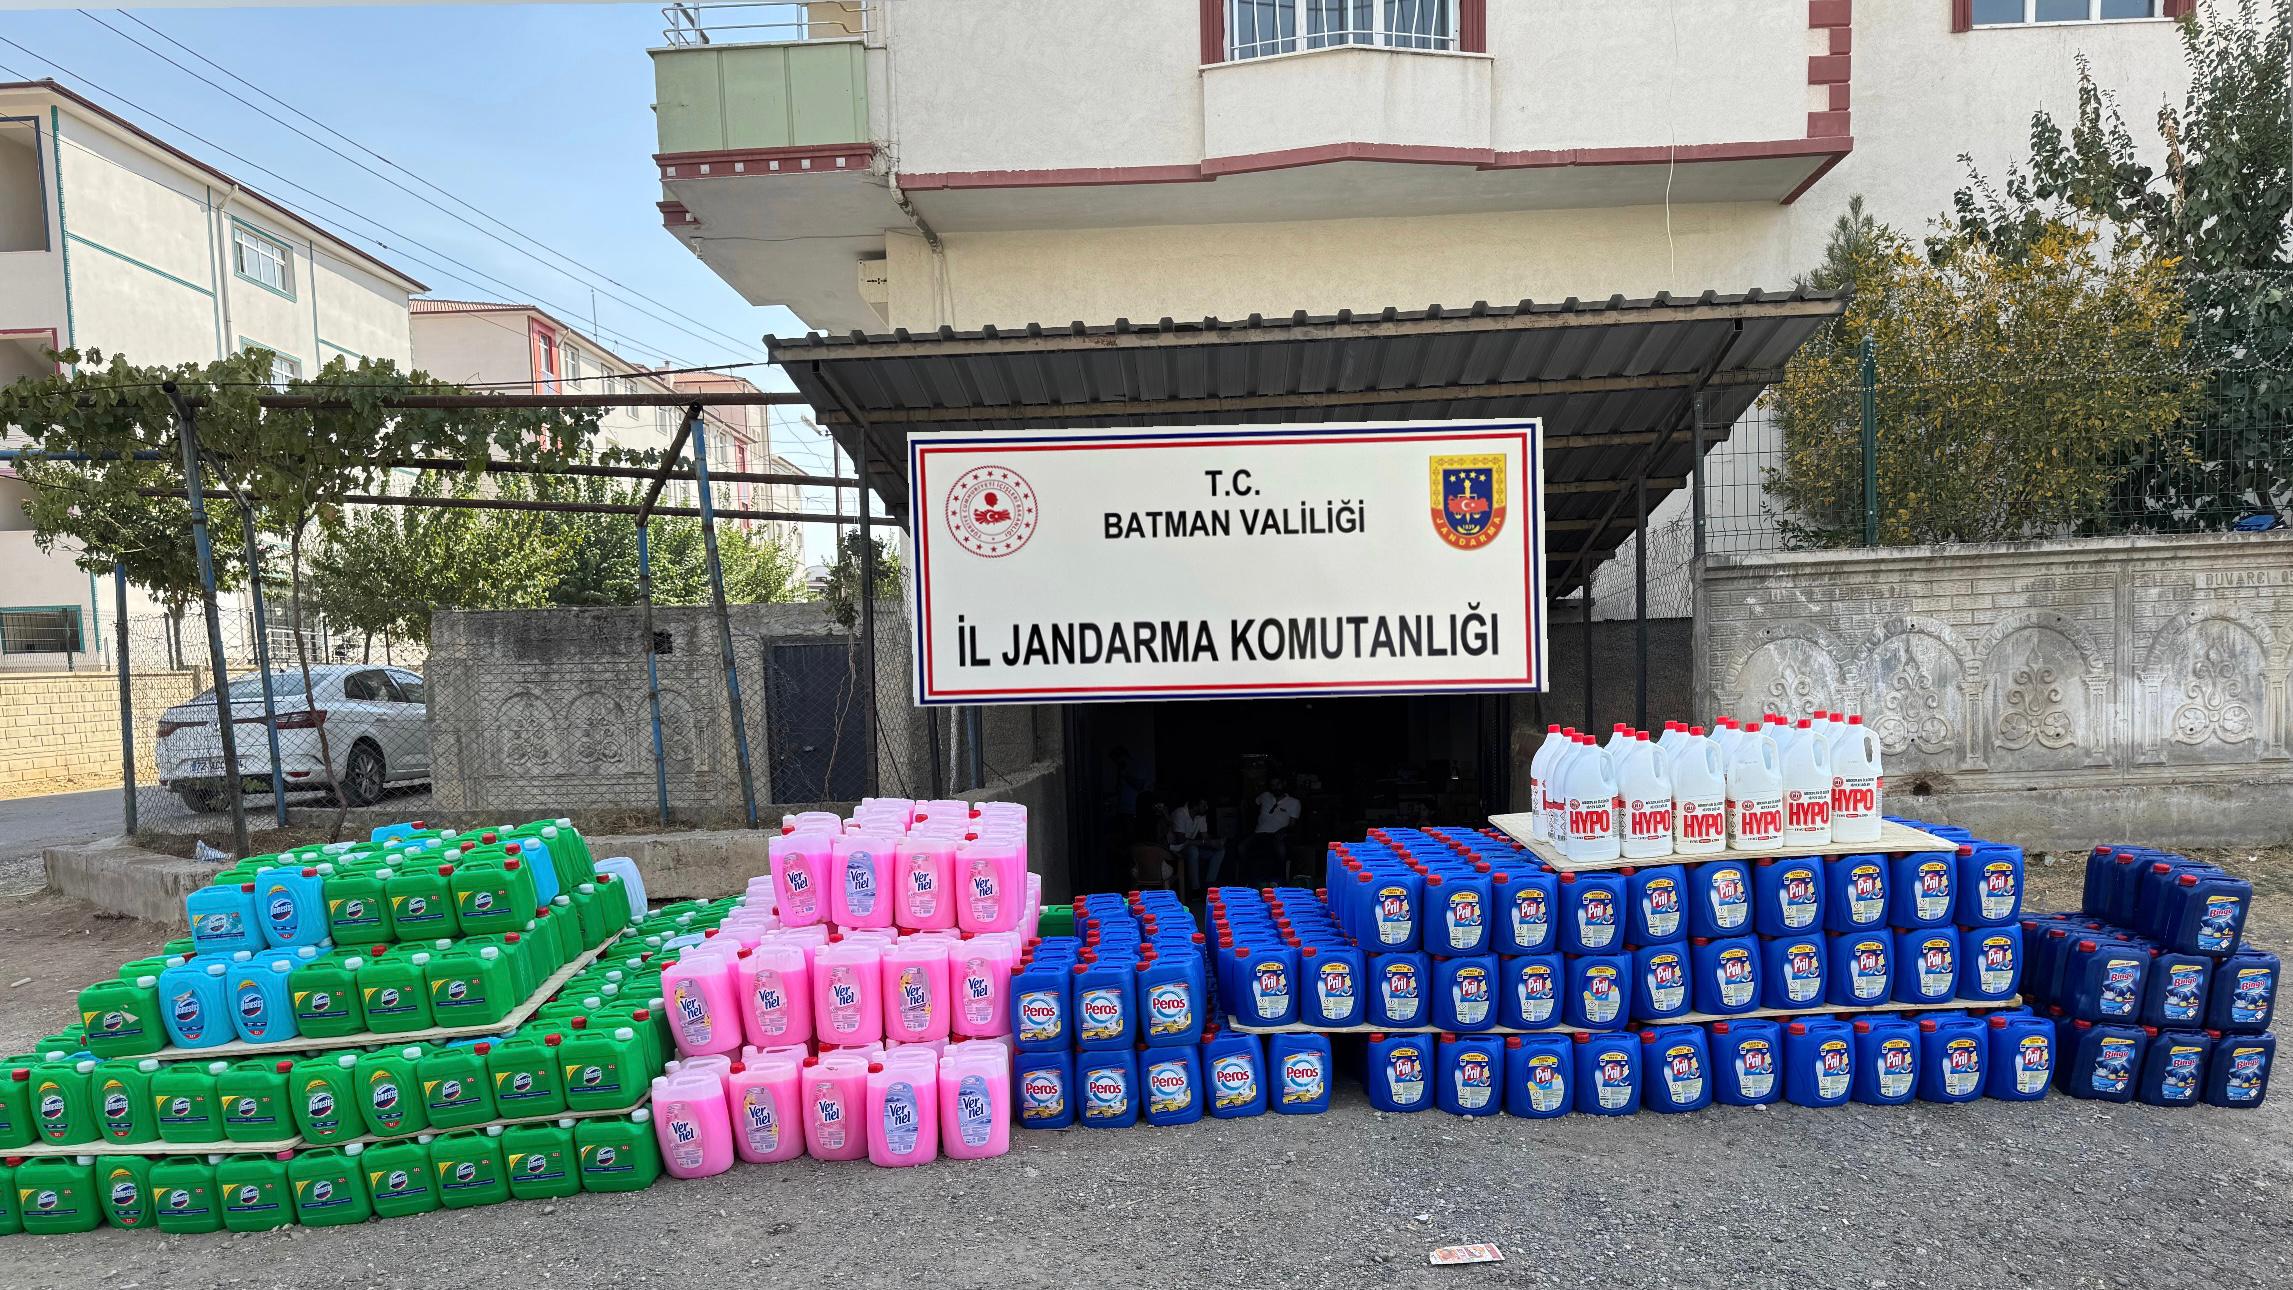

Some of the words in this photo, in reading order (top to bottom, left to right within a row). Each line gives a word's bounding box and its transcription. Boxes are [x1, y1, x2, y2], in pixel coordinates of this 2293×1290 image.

[1205, 470, 1260, 496] T.C.
[1105, 510, 1229, 538] BATMAN
[1243, 499, 1365, 535] VALİLİĞİ
[1436, 517, 1501, 546] JANDARMA
[958, 614, 990, 666] İL
[1002, 621, 1218, 666] JANDARMA
[1231, 602, 1498, 662] KOMUTANLIĞI
[1831, 788, 1873, 811] HYPO
[1789, 801, 1829, 826] HYPO
[1570, 810, 1610, 834] HYPO
[1632, 810, 1670, 834] HYPO
[1683, 813, 1723, 837] HYPO
[1742, 810, 1781, 834] HYPO
[1858, 878, 1872, 891] Pril
[1924, 876, 1939, 889] Pril
[1990, 876, 2004, 889] Pril
[1720, 884, 1734, 897] Pril
[1790, 884, 1804, 897] Pril
[1652, 893, 1667, 906] Pril
[1384, 901, 1399, 914] Pril
[1457, 906, 1471, 919] Pril
[1522, 903, 1536, 916] Pril
[1588, 904, 1602, 917] Pril
[1860, 956, 1875, 969] Pril
[1928, 953, 1942, 966] Pril
[1988, 950, 2002, 964] Pril
[1727, 962, 1741, 976] Pril
[1794, 959, 1808, 972] Pril
[1656, 968, 1671, 982] Pril
[1262, 976, 1276, 989] Pril
[1327, 976, 1342, 989] Pril
[1392, 977, 1406, 990] Pril
[1463, 981, 1477, 994] Pril
[1528, 979, 1542, 992] Pril
[1593, 979, 1607, 992] Pril
[1085, 1003, 1118, 1014] Peros
[1153, 998, 1185, 1009] Peros
[1023, 1005, 1055, 1016] Peros
[1746, 1054, 1760, 1067] Pril
[1825, 1055, 1840, 1068] Pril
[1887, 1054, 1901, 1067] Pril
[1953, 1053, 1967, 1066] Pril
[2025, 1049, 2039, 1063] Pril
[1286, 1066, 1318, 1078] Peros
[1396, 1062, 1411, 1075] Pril
[1465, 1066, 1479, 1079] Pril
[1605, 1066, 1620, 1079] Pril
[1673, 1061, 1688, 1074] Pril
[1152, 1076, 1184, 1088] Peros
[1217, 1071, 1249, 1083] Peros
[1536, 1069, 1550, 1082] Pril
[1026, 1082, 1058, 1094] Peros
[1090, 1082, 1121, 1094] Peros
